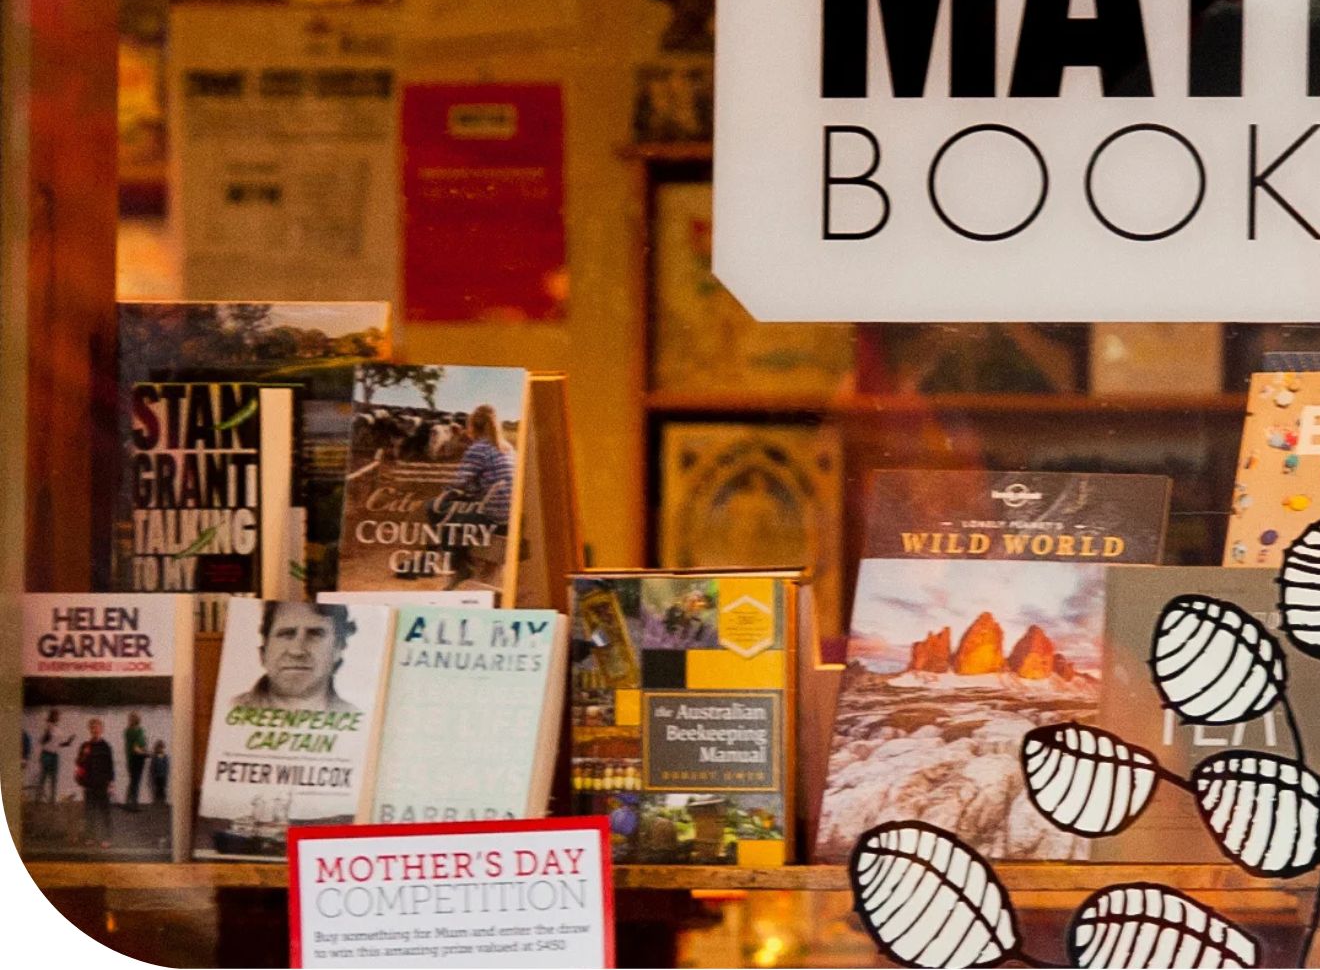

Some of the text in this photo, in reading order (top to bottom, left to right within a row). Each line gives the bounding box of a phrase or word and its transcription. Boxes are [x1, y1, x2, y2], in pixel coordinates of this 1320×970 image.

[132, 383, 258, 451] STAN
[133, 453, 257, 508] GRANT
[433, 480, 507, 523] Girl
[133, 508, 257, 555] TALKING
[355, 520, 498, 546] COUNTRY
[901, 532, 1125, 557] WILD WORLD
[133, 556, 159, 590] TO
[163, 556, 198, 590] MY
[389, 549, 456, 575] GIRL
[52, 606, 139, 630] HELEN
[404, 616, 548, 648] ALL MY
[37, 634, 153, 658] GARNER
[37, 661, 112, 671] EVERYWHERE
[400, 648, 542, 671] JANUARIES
[225, 705, 365, 731] GREENPEACE
[676, 702, 767, 720] Australian
[246, 731, 337, 753] CAPTAIN
[666, 724, 767, 745] Beekeeping
[699, 746, 767, 763] Manual
[215, 761, 353, 788] PETER WILLCOX
[316, 848, 585, 883] MOTHER'S DAY
[315, 879, 587, 918] COMPETITION
[313, 923, 590, 944] Buy something for Mum and enter the draw
[314, 948, 326, 958] to
[330, 948, 354, 957] win
[356, 946, 380, 957] this
[384, 946, 438, 957] amazing
[440, 944, 473, 956] prize
[476, 942, 518, 952] valued
[521, 942, 533, 951] at
